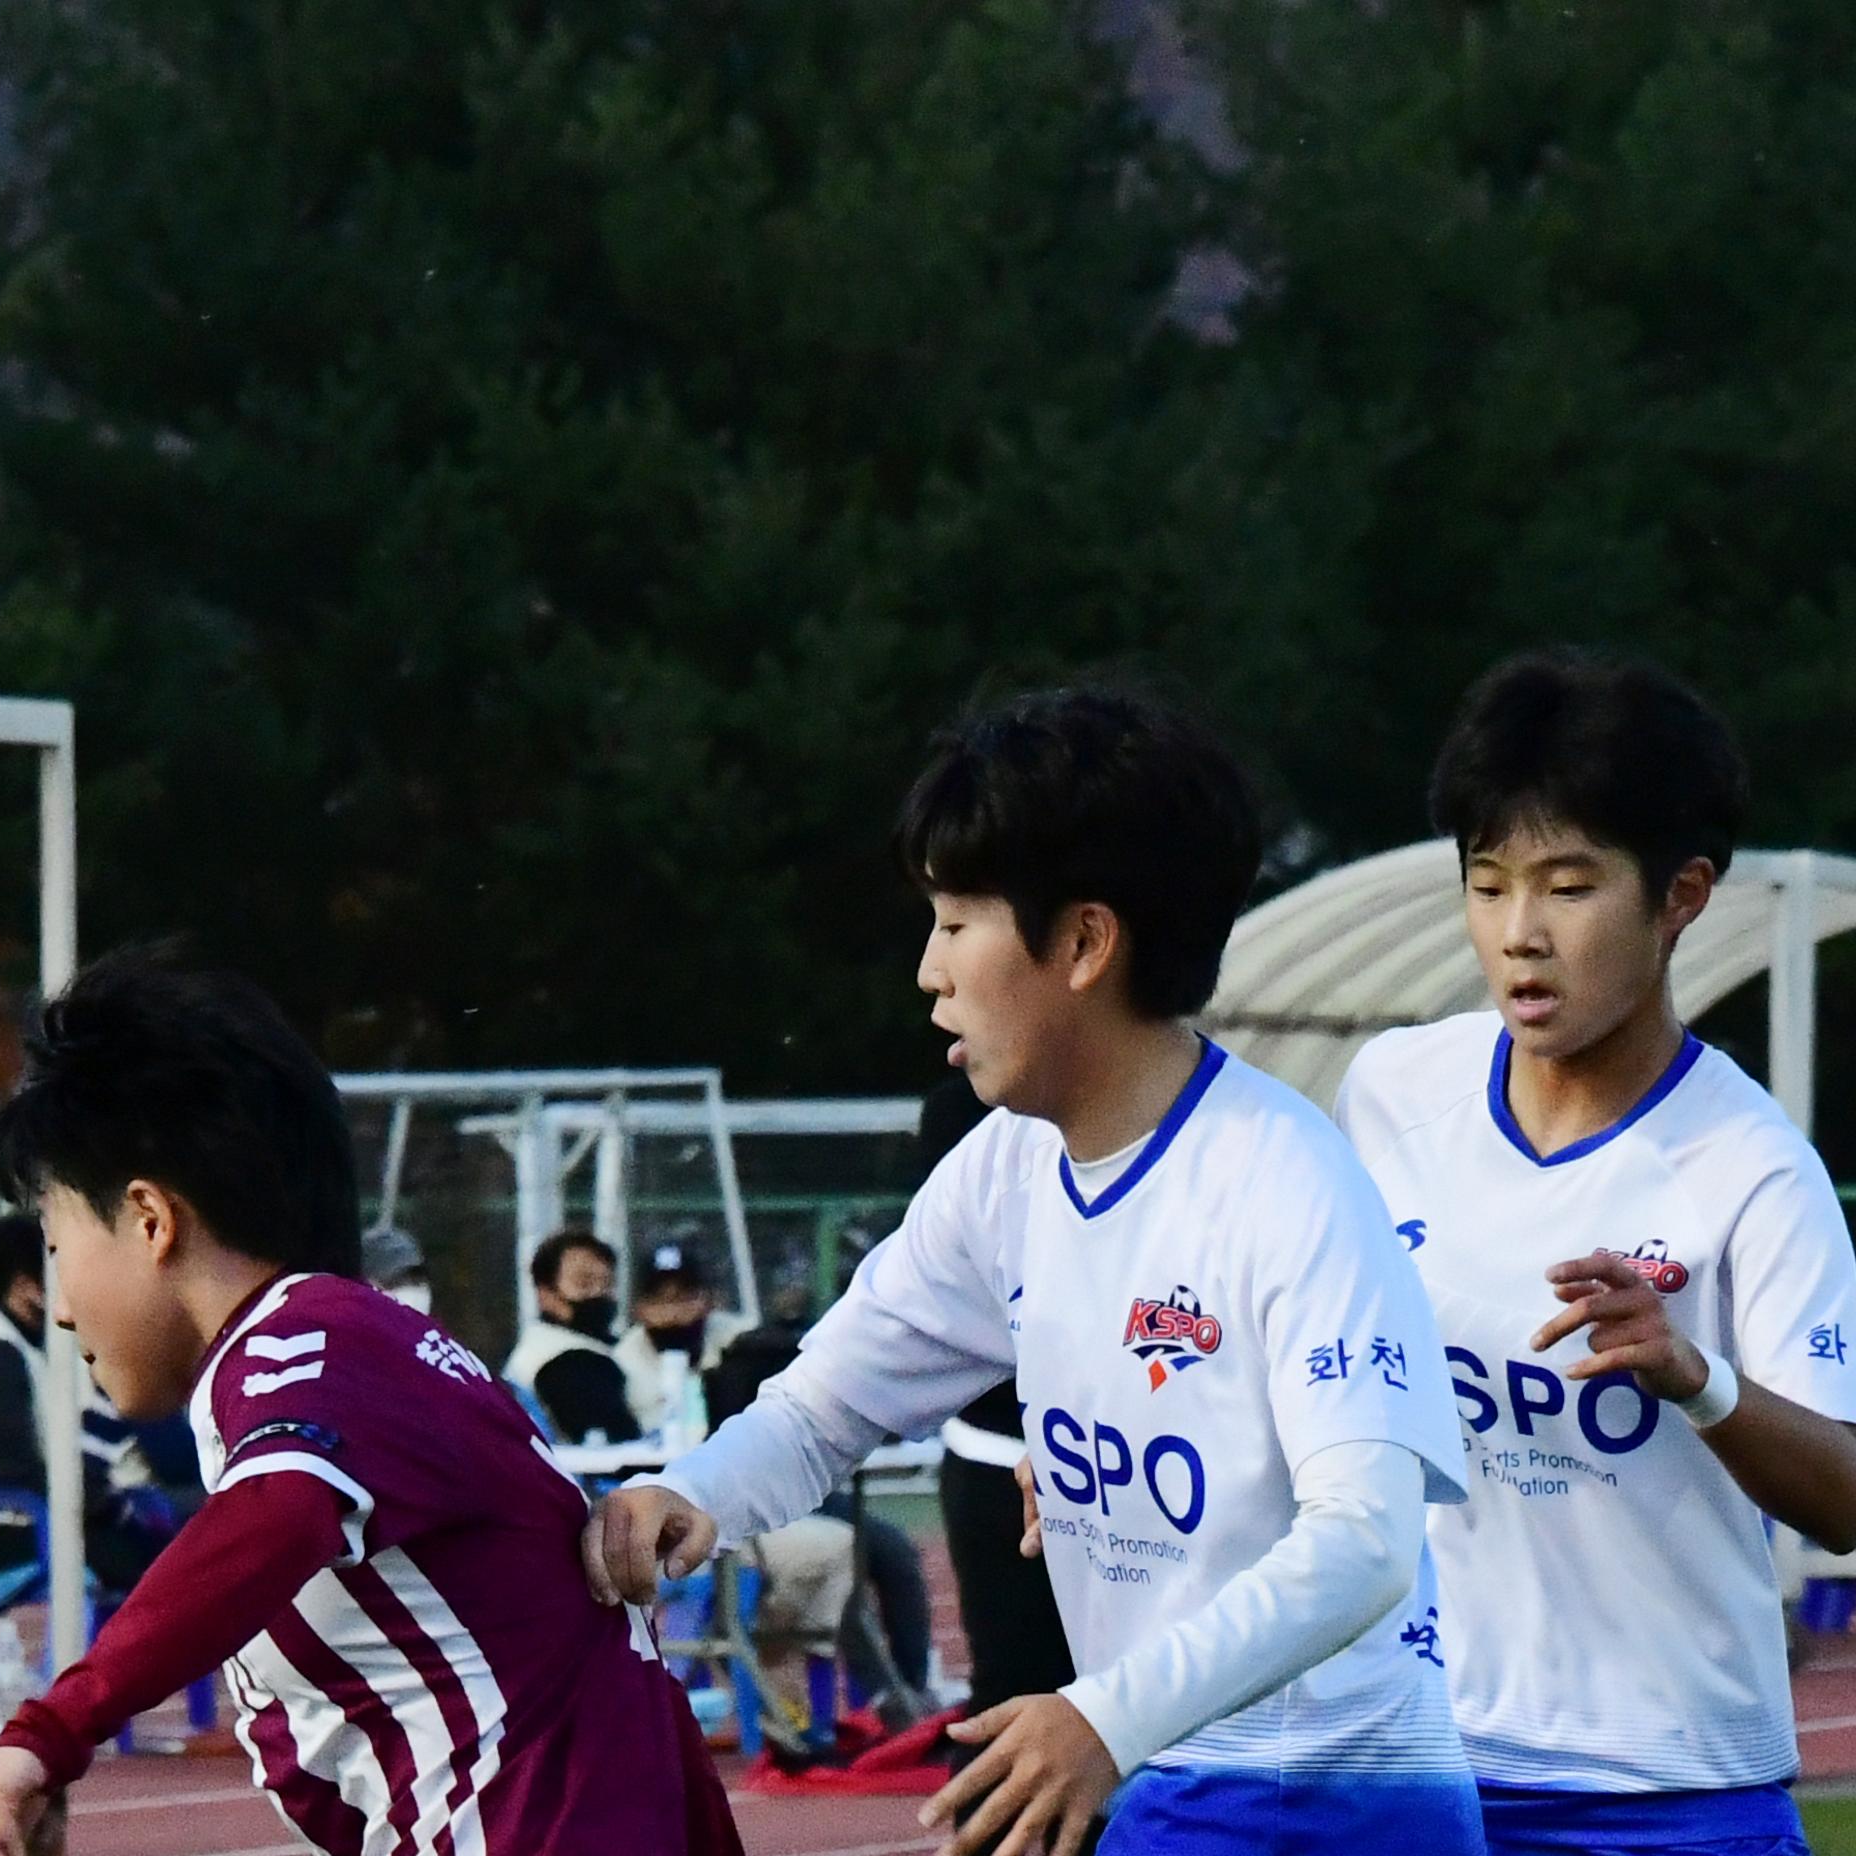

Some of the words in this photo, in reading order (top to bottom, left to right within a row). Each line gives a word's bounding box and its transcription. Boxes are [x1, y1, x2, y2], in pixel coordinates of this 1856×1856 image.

[1122, 1298, 1222, 1354] KSPO
[1305, 1337, 1408, 1391] 화천
[1018, 1402, 1205, 1534] SPO
[1108, 1533, 1188, 1564] Promotion
